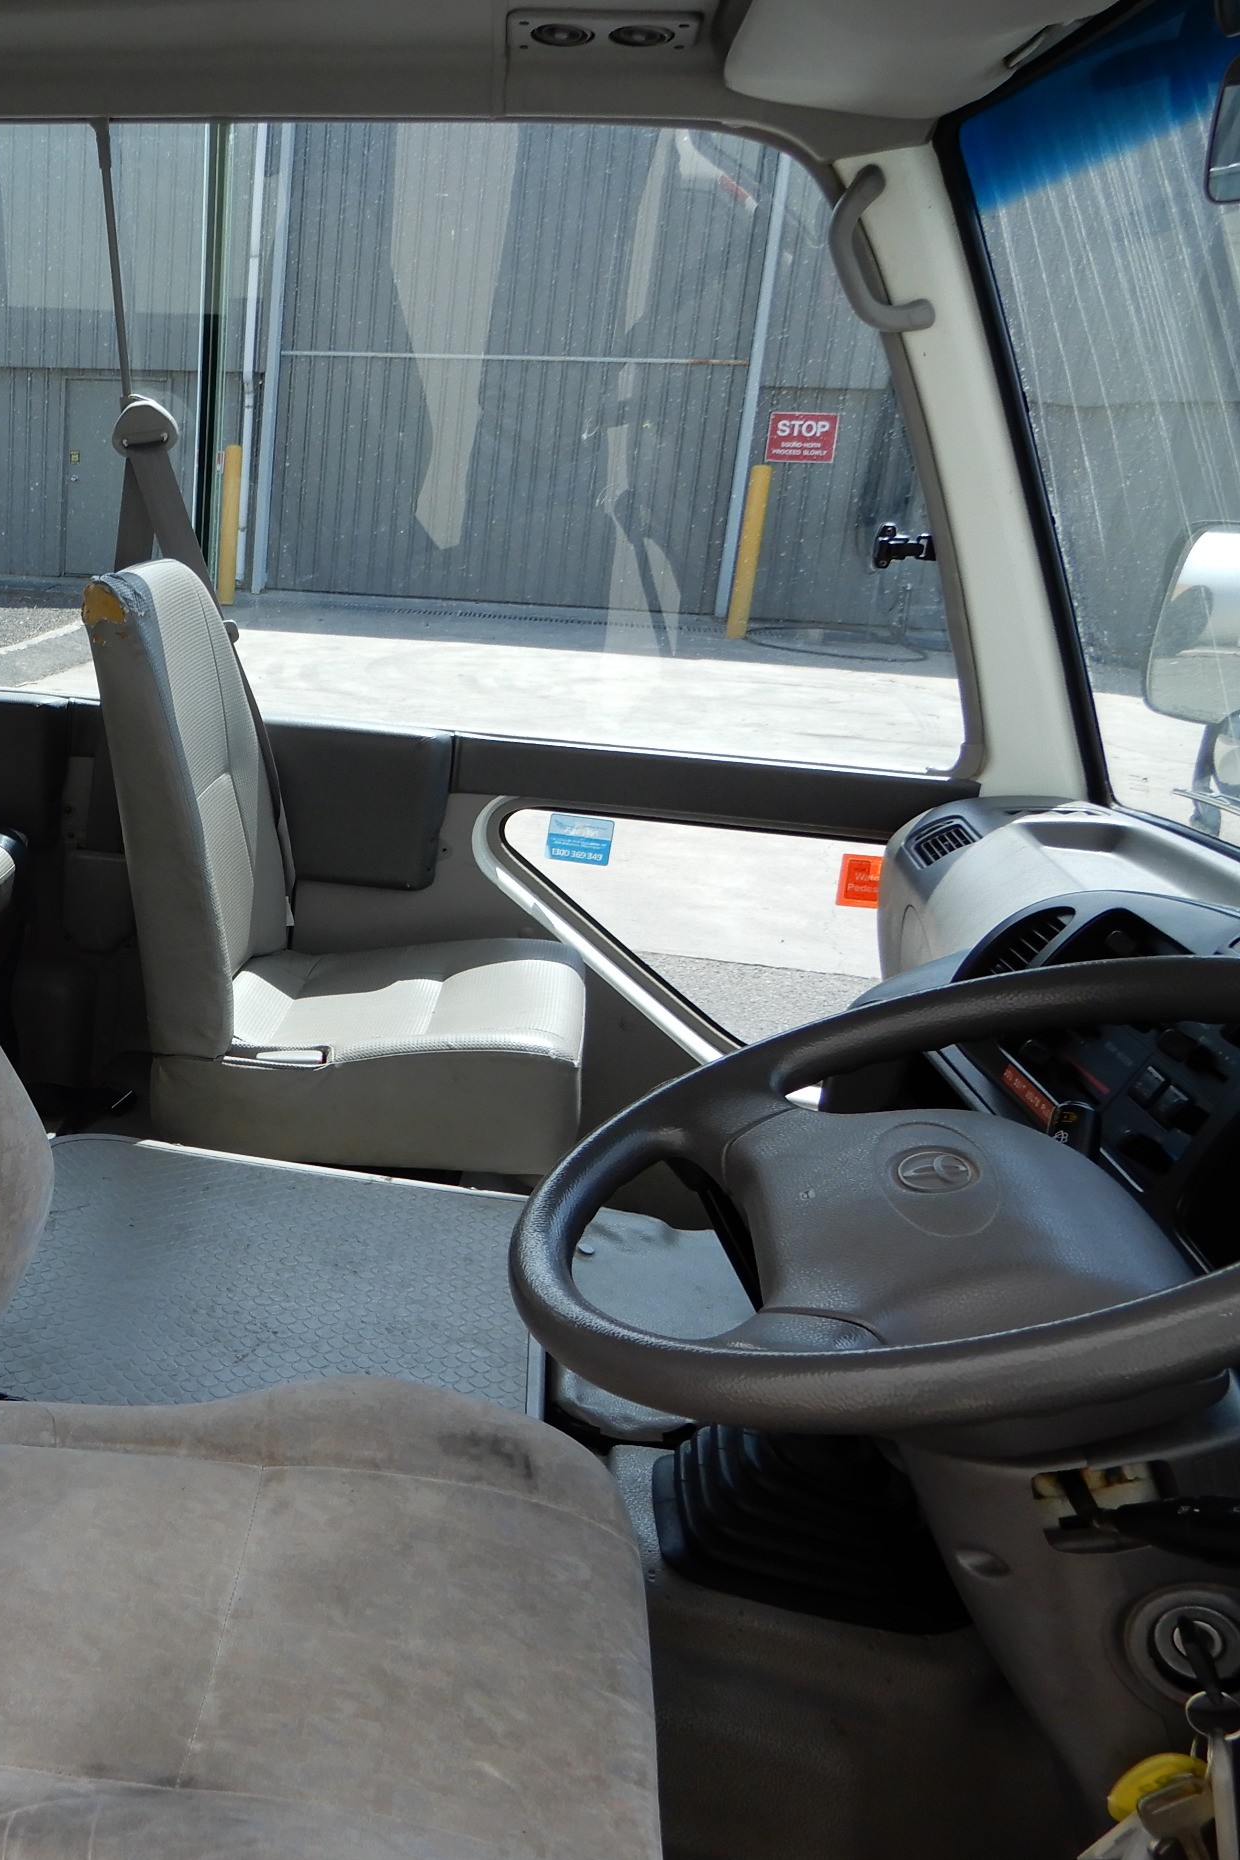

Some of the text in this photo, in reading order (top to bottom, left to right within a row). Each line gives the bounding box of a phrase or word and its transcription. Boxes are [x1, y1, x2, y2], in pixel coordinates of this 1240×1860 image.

[776, 420, 830, 437] STOP
[551, 847, 603, 861] 1300 369 349
